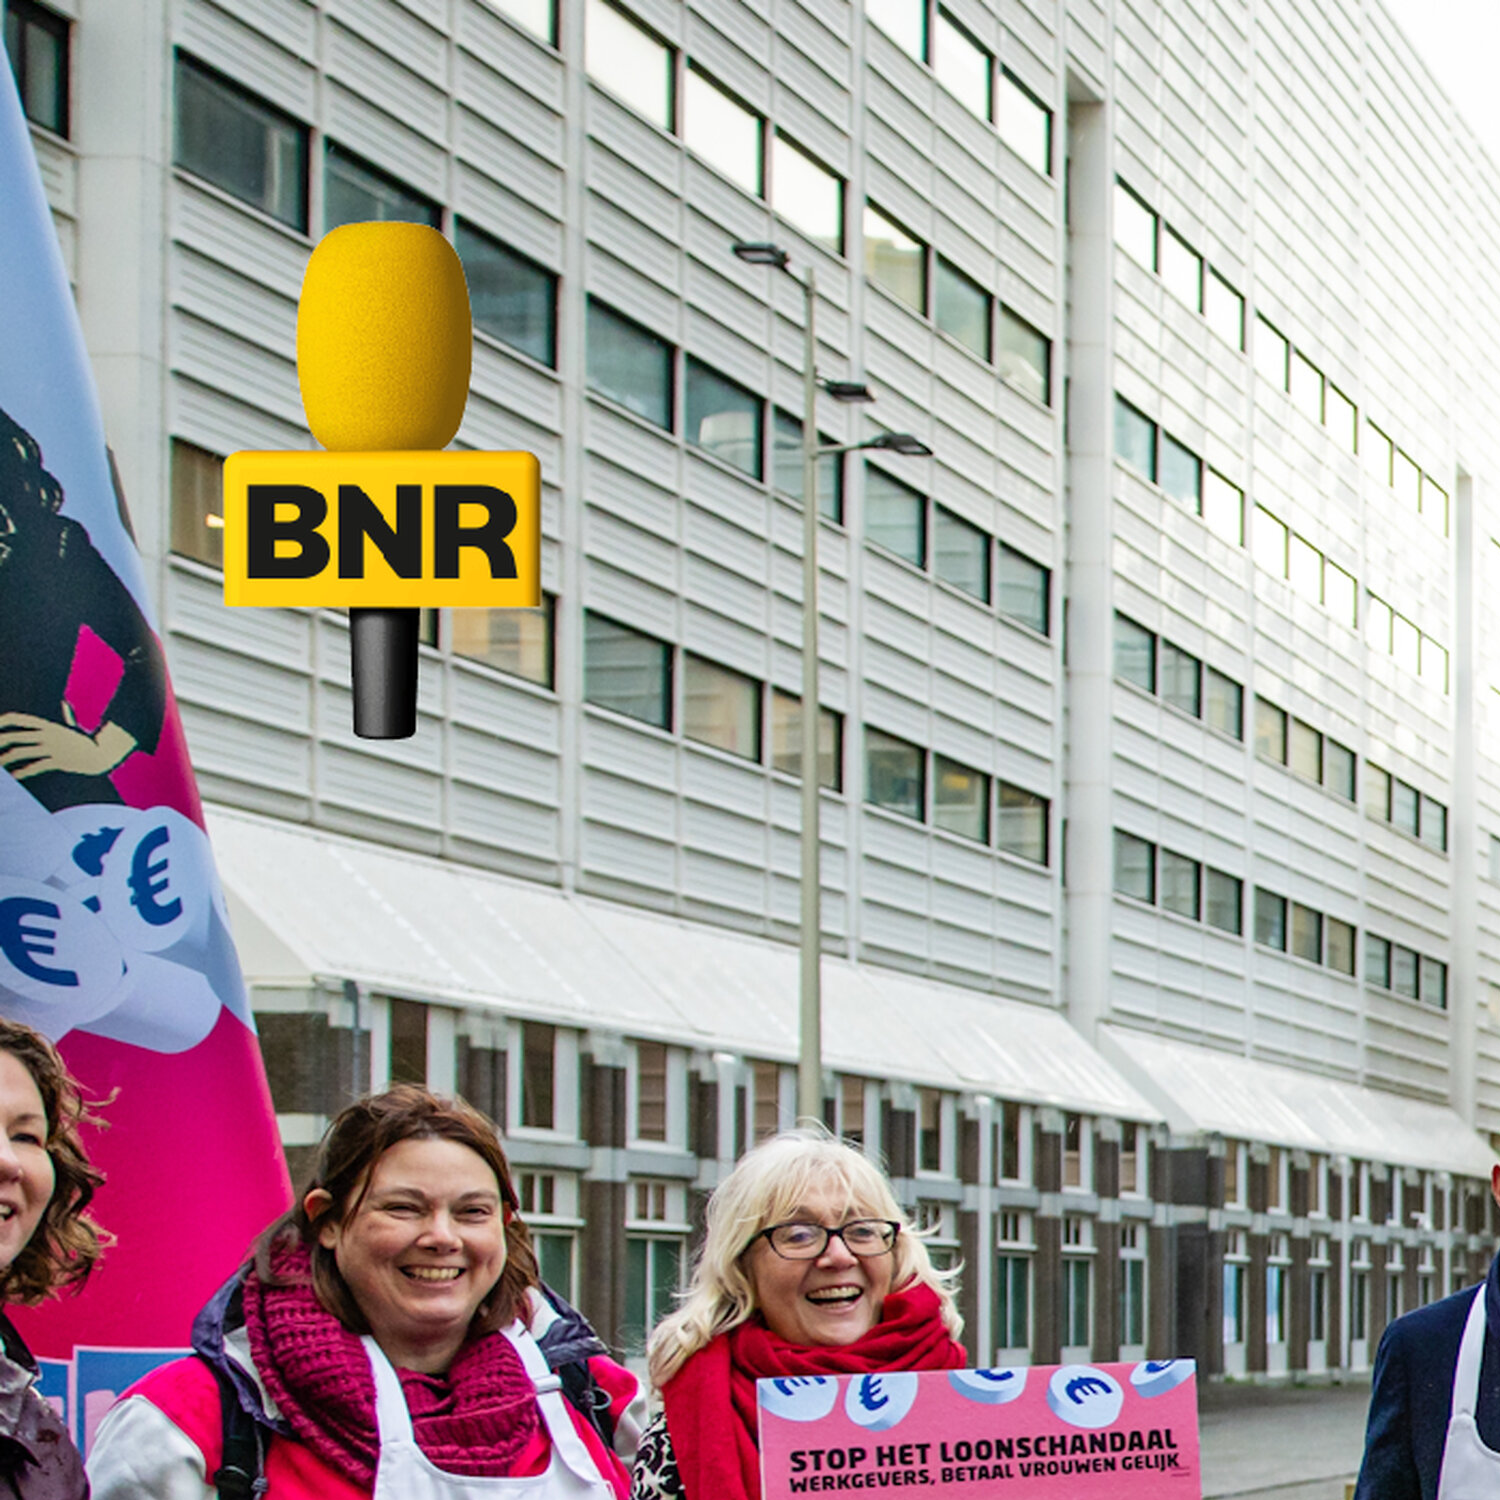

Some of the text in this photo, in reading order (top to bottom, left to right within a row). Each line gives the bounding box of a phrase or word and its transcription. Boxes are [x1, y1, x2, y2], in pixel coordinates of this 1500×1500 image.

[790, 1429, 1177, 1473] STOP HET LOONSCHANDAAL
[789, 1453, 1180, 1493] WERKGEVERS, BETAAL VROUWEN GELIJK
